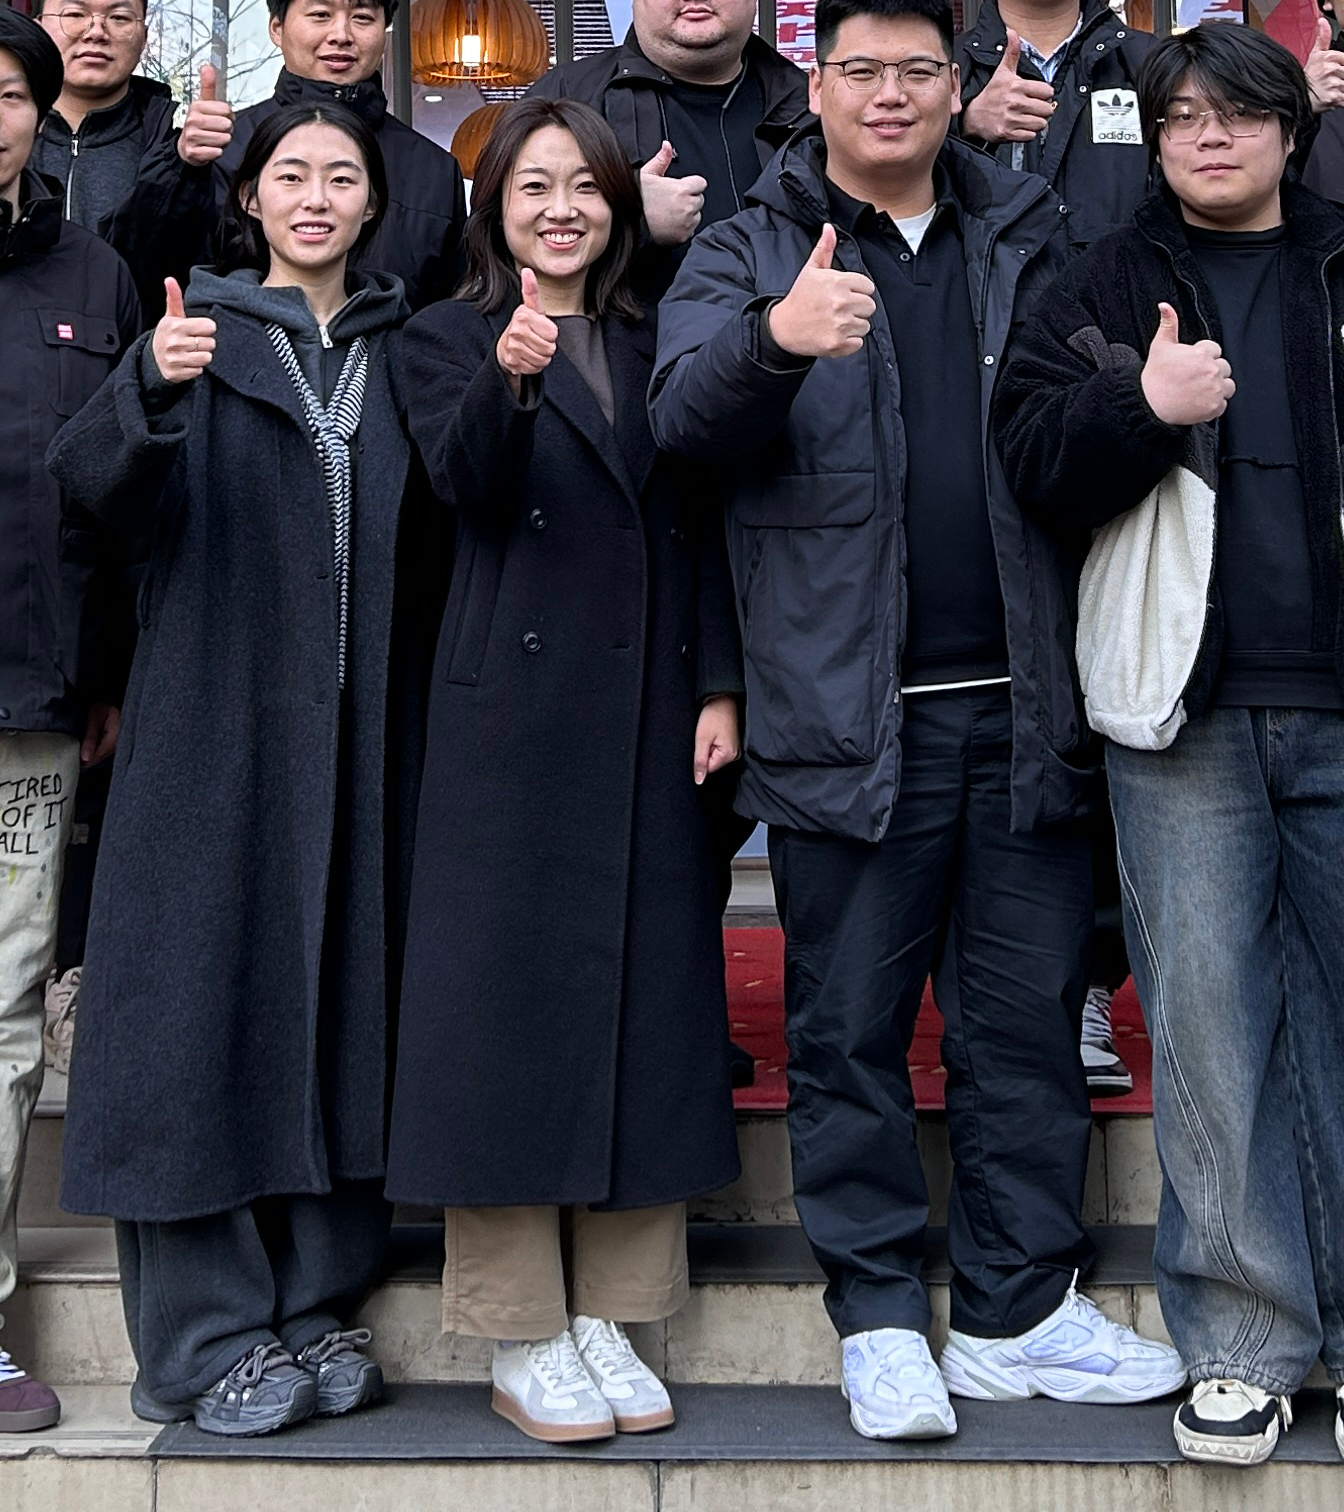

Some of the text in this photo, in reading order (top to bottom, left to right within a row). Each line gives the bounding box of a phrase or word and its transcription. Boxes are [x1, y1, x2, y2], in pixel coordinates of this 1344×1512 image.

[1098, 131, 1138, 142] adidas
[2, 796, 68, 830] OF IT
